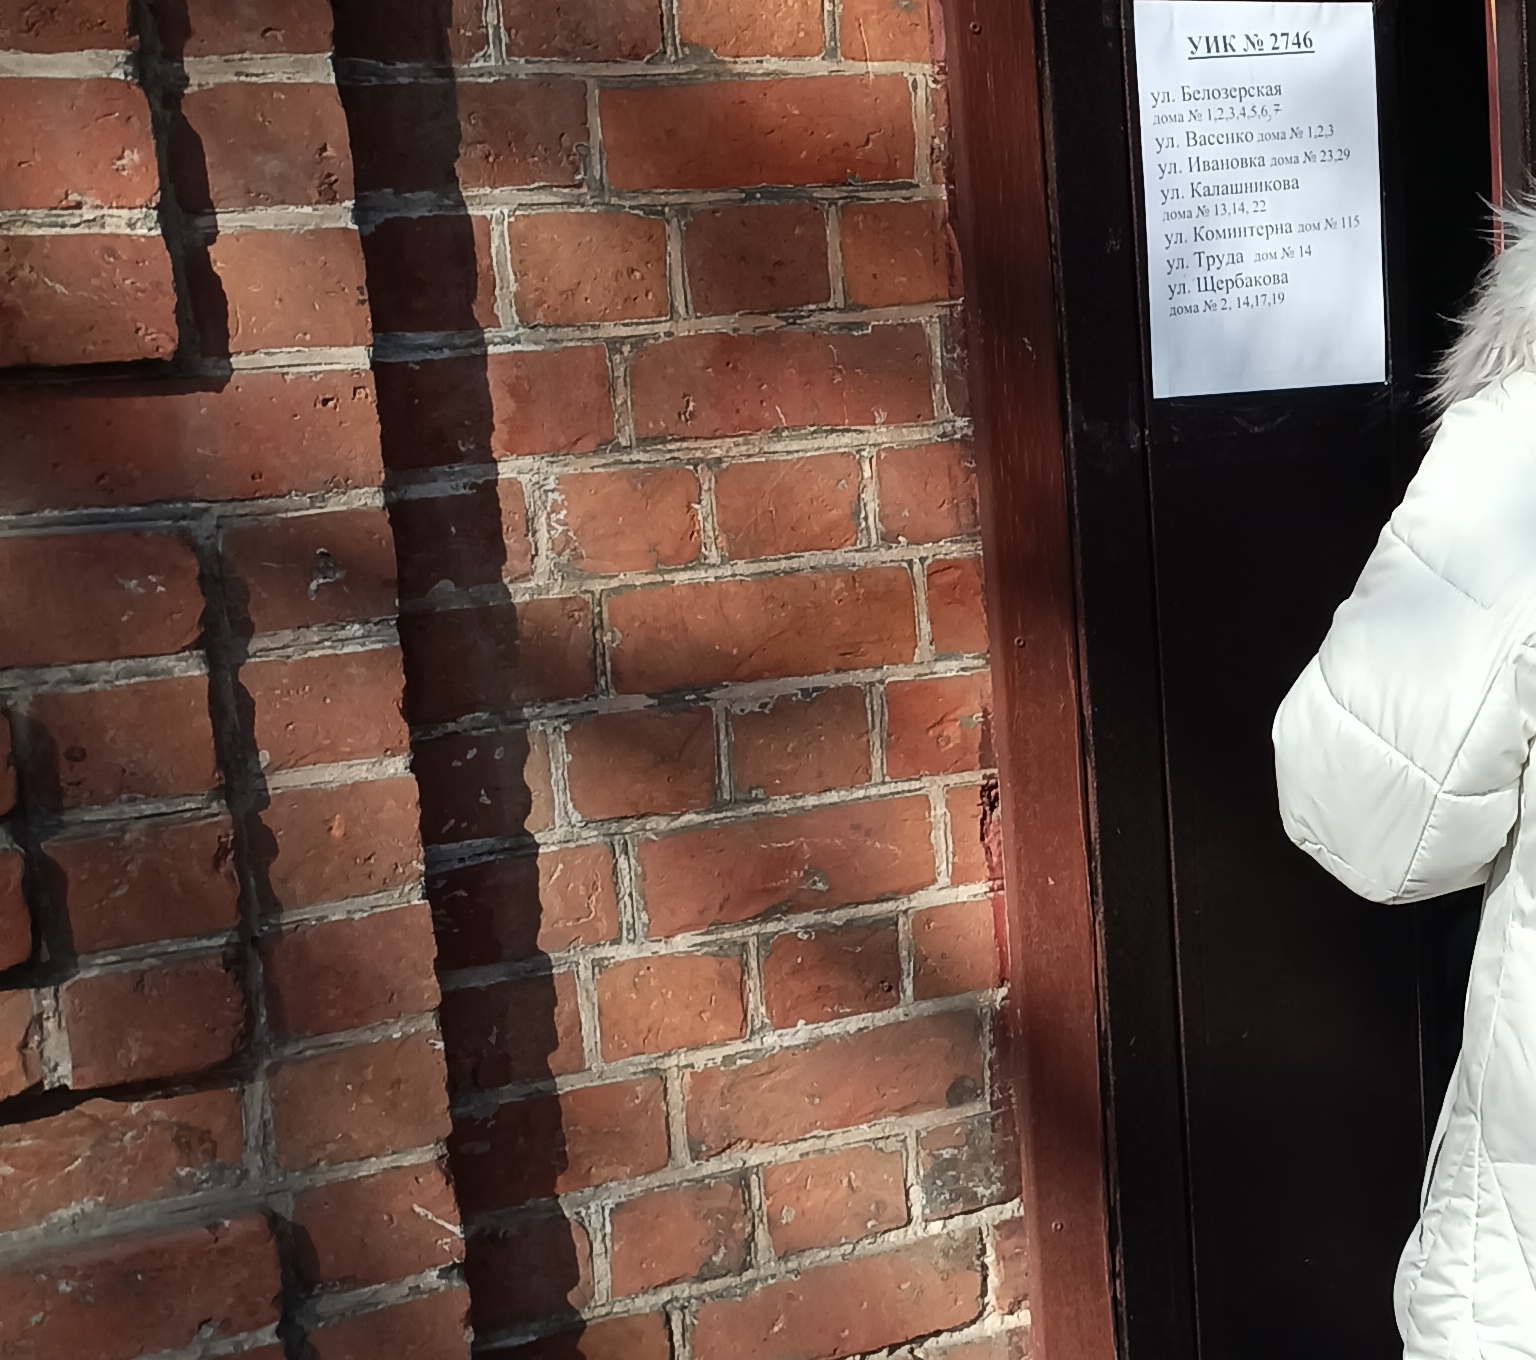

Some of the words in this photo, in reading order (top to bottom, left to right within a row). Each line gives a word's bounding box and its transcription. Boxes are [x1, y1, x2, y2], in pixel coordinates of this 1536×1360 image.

[1188, 35, 1236, 55] УИК
[1243, 33, 1264, 52] №
[1269, 31, 1314, 51] 2746
[1151, 91, 1175, 108] ул.
[1181, 84, 1282, 103] Белозерская
[1153, 113, 1184, 125] дома
[1188, 109, 1203, 122] №
[1155, 137, 1180, 154] ул.
[1186, 130, 1254, 148] Васенко
[1257, 132, 1287, 143] дома
[1290, 127, 1304, 139] №
[1307, 124, 1334, 139] 1,2,3
[1158, 161, 1183, 180] ул.
[1188, 155, 1265, 173] Ивановка
[1270, 156, 1299, 168] дома
[1302, 151, 1317, 164] №
[1320, 148, 1351, 164] 23,29
[1160, 187, 1185, 205] ул.
[1190, 178, 1300, 199] Калашникова
[1162, 210, 1193, 222] дома
[1196, 205, 1210, 218] №
[1252, 200, 1267, 213] 22
[1164, 231, 1188, 249] ул.
[1193, 221, 1293, 242] Коминтерна
[1297, 222, 1321, 234] дом
[1324, 218, 1338, 231] №
[1341, 215, 1360, 229] 115
[1166, 256, 1189, 275] ул.
[1193, 250, 1244, 271] Труда
[1253, 251, 1277, 263] дом
[1281, 246, 1295, 260] №
[1299, 245, 1312, 258] 14
[1168, 282, 1191, 300] ул.
[1196, 272, 1289, 294] Щербакова
[1169, 305, 1199, 317] дома
[1202, 299, 1218, 313] №
[1236, 292, 1285, 309] 14,17,19
